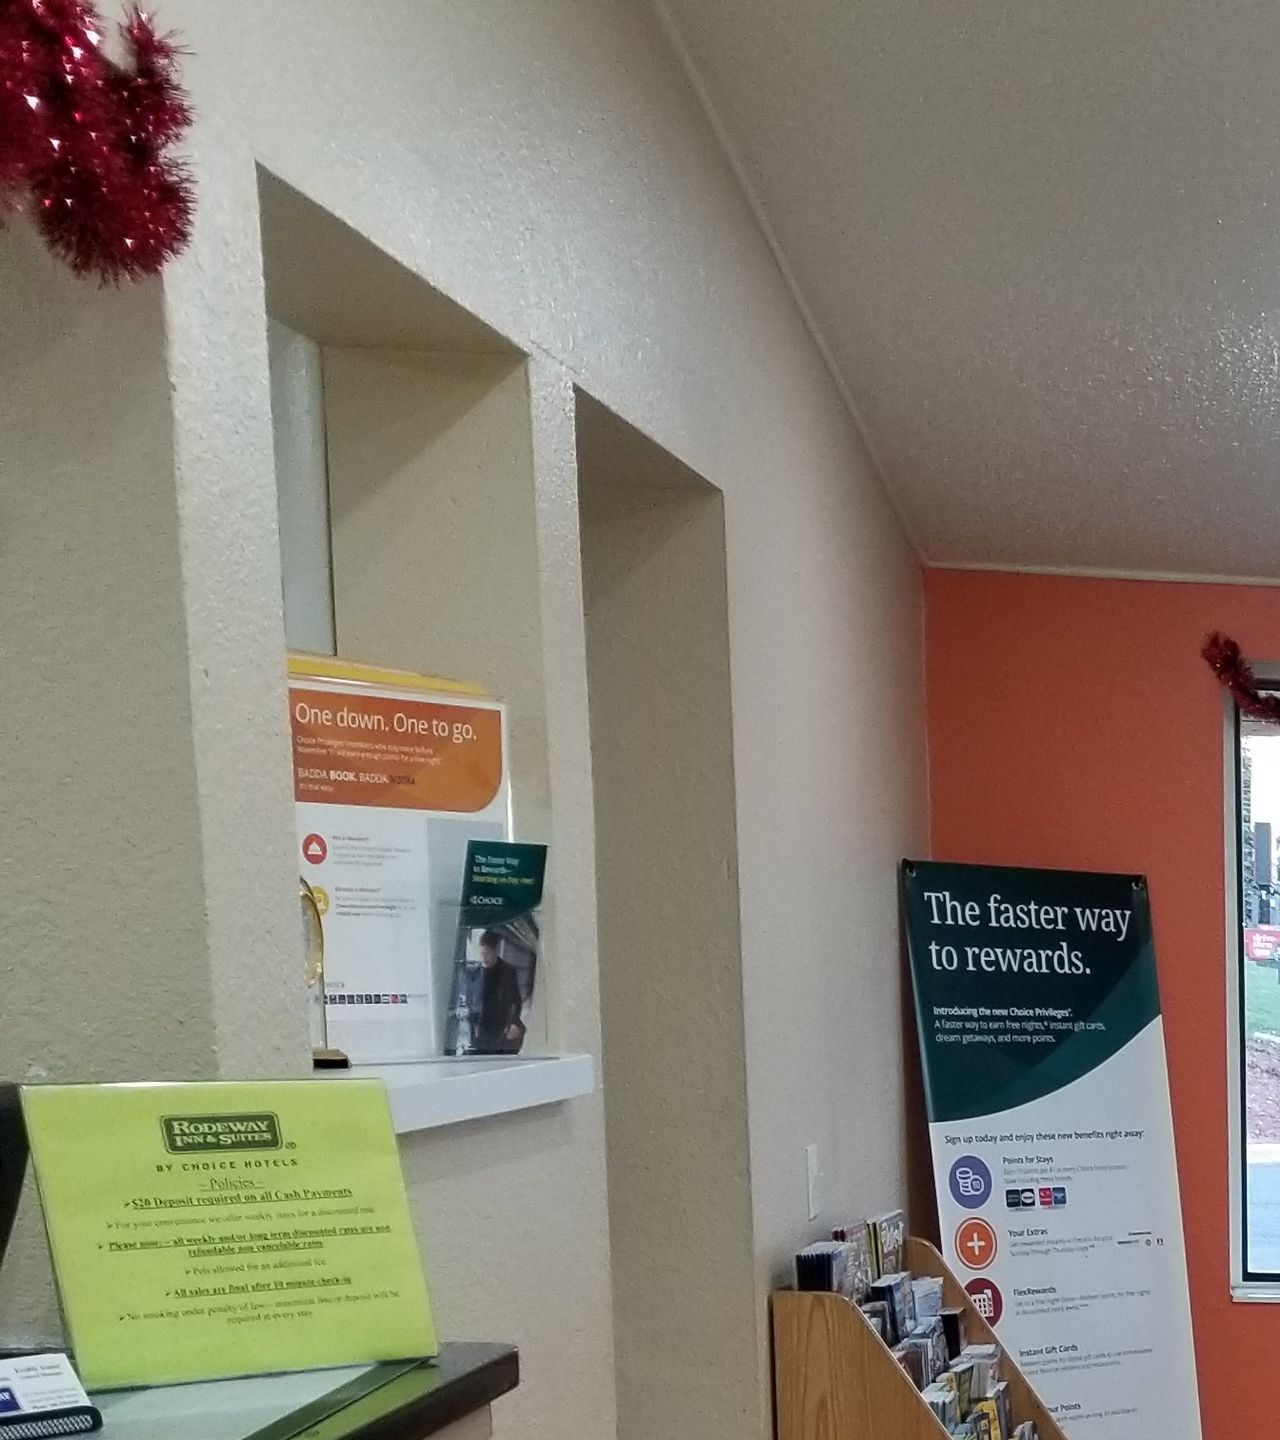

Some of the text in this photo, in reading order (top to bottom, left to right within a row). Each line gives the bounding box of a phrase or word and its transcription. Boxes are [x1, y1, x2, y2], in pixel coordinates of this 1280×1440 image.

[295, 703, 477, 743] One down. One to go.
[298, 768, 328, 779] BADDA
[358, 772, 389, 784] BADDA
[924, 891, 1131, 942] The faster way
[928, 940, 1091, 975] to rewards.
[933, 1006, 978, 1017] Introducing
[979, 1006, 991, 1016] the
[992, 1008, 1008, 1016] new
[1009, 1007, 1034, 1016] Choice
[934, 1019, 940, 1028] A
[941, 1019, 963, 1029] faster
[964, 1021, 979, 1031] way
[979, 1021, 988, 1029] to
[988, 1021, 1005, 1029] earn
[1005, 1020, 1020, 1029] free
[936, 1033, 961, 1042] dream
[997, 1033, 1011, 1042] and
[1011, 1034, 1031, 1042] more
[170, 1119, 270, 1135] RODEWAY
[174, 1132, 272, 1147] INN & SUITES
[944, 1135, 961, 1145] Sign
[963, 1135, 974, 1145] up
[975, 1132, 998, 1144] today
[999, 1132, 1013, 1142] and
[1015, 1131, 1034, 1143] enjoy
[1036, 1131, 1056, 1140] these
[1057, 1132, 1073, 1140] new
[1074, 1129, 1104, 1140] benefits
[1105, 1129, 1122, 1140] right
[156, 1158, 298, 1172] BY CHOICE HOTELS
[1002, 1154, 1054, 1165] Points for Stays
[153, 1196, 193, 1208] Deposit
[196, 1193, 241, 1207] required
[244, 1194, 257, 1202] on
[260, 1190, 272, 1202] all
[274, 1189, 301, 1201] Cash
[303, 1187, 353, 1200] Payments
[1019, 1343, 1079, 1357] Instant Gift Cards
[1047, 1402, 1081, 1413] our Points
